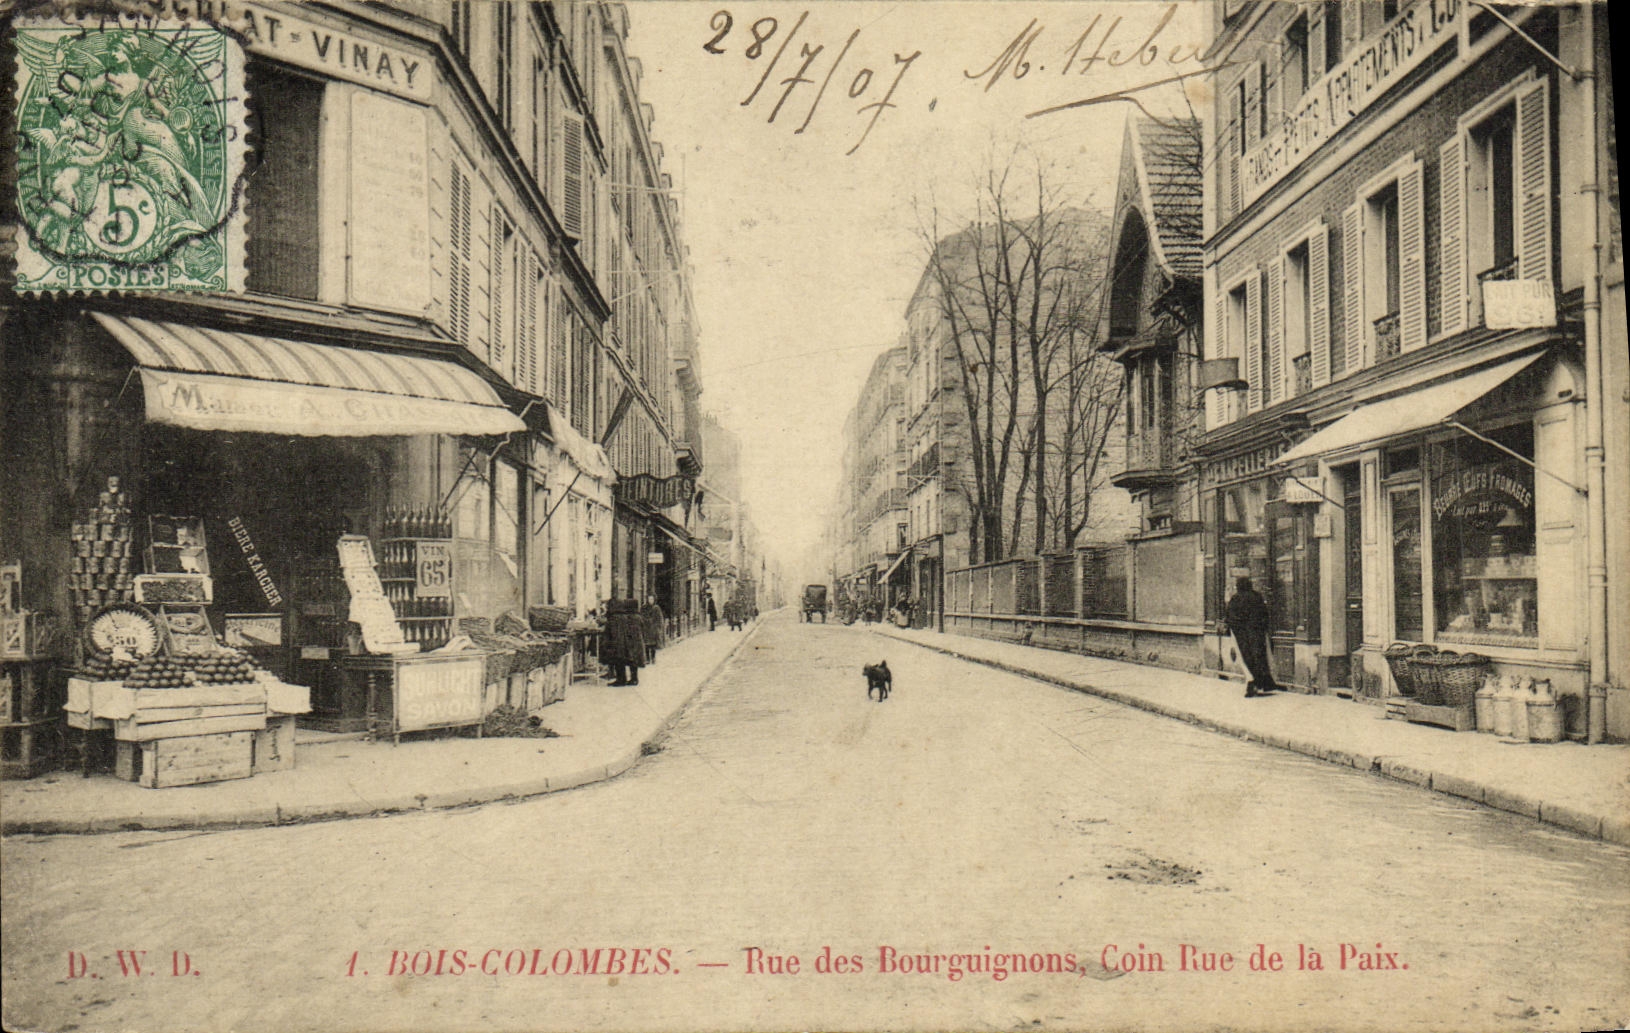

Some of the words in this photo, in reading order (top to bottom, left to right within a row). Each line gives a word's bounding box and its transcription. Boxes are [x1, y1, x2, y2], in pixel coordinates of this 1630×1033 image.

[71, 265, 166, 288] POSTES
[1521, 282, 1552, 299] PUR
[620, 475, 692, 504] TEINTURES
[1488, 466, 1532, 509] FROMAGES
[228, 516, 255, 554] BIERE
[420, 544, 447, 557] VIN
[419, 558, 446, 589] 65
[406, 696, 478, 721] SAVON
